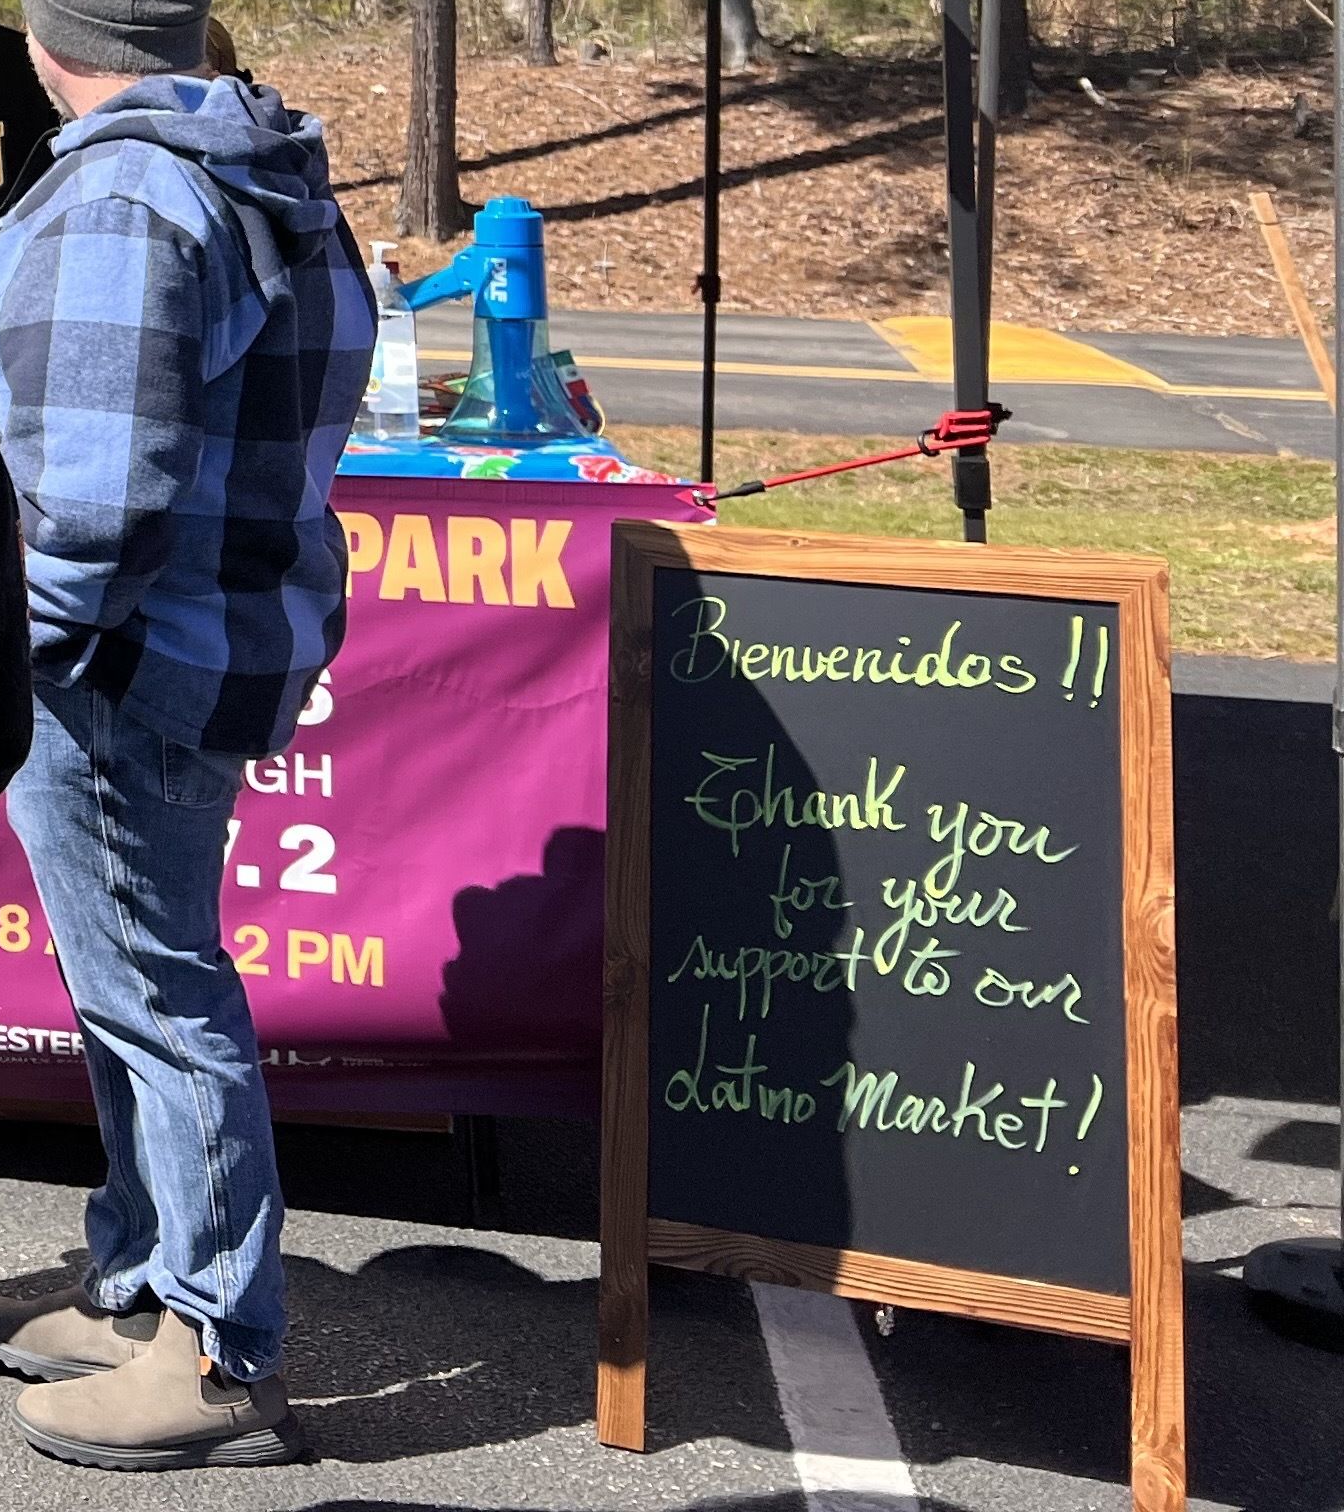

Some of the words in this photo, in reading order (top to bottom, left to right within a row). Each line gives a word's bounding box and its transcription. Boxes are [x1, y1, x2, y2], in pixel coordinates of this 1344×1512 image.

[490, 257, 508, 304] PYLE
[335, 511, 576, 609] PARK
[670, 596, 1037, 693] Bienvenidos
[925, 802, 1081, 899] you
[233, 924, 270, 976] 2
[287, 929, 384, 987] PM
[770, 844, 855, 939] for
[873, 876, 1031, 975] your
[667, 928, 875, 1021] support
[904, 937, 962, 997] to
[974, 967, 1091, 1025] our
